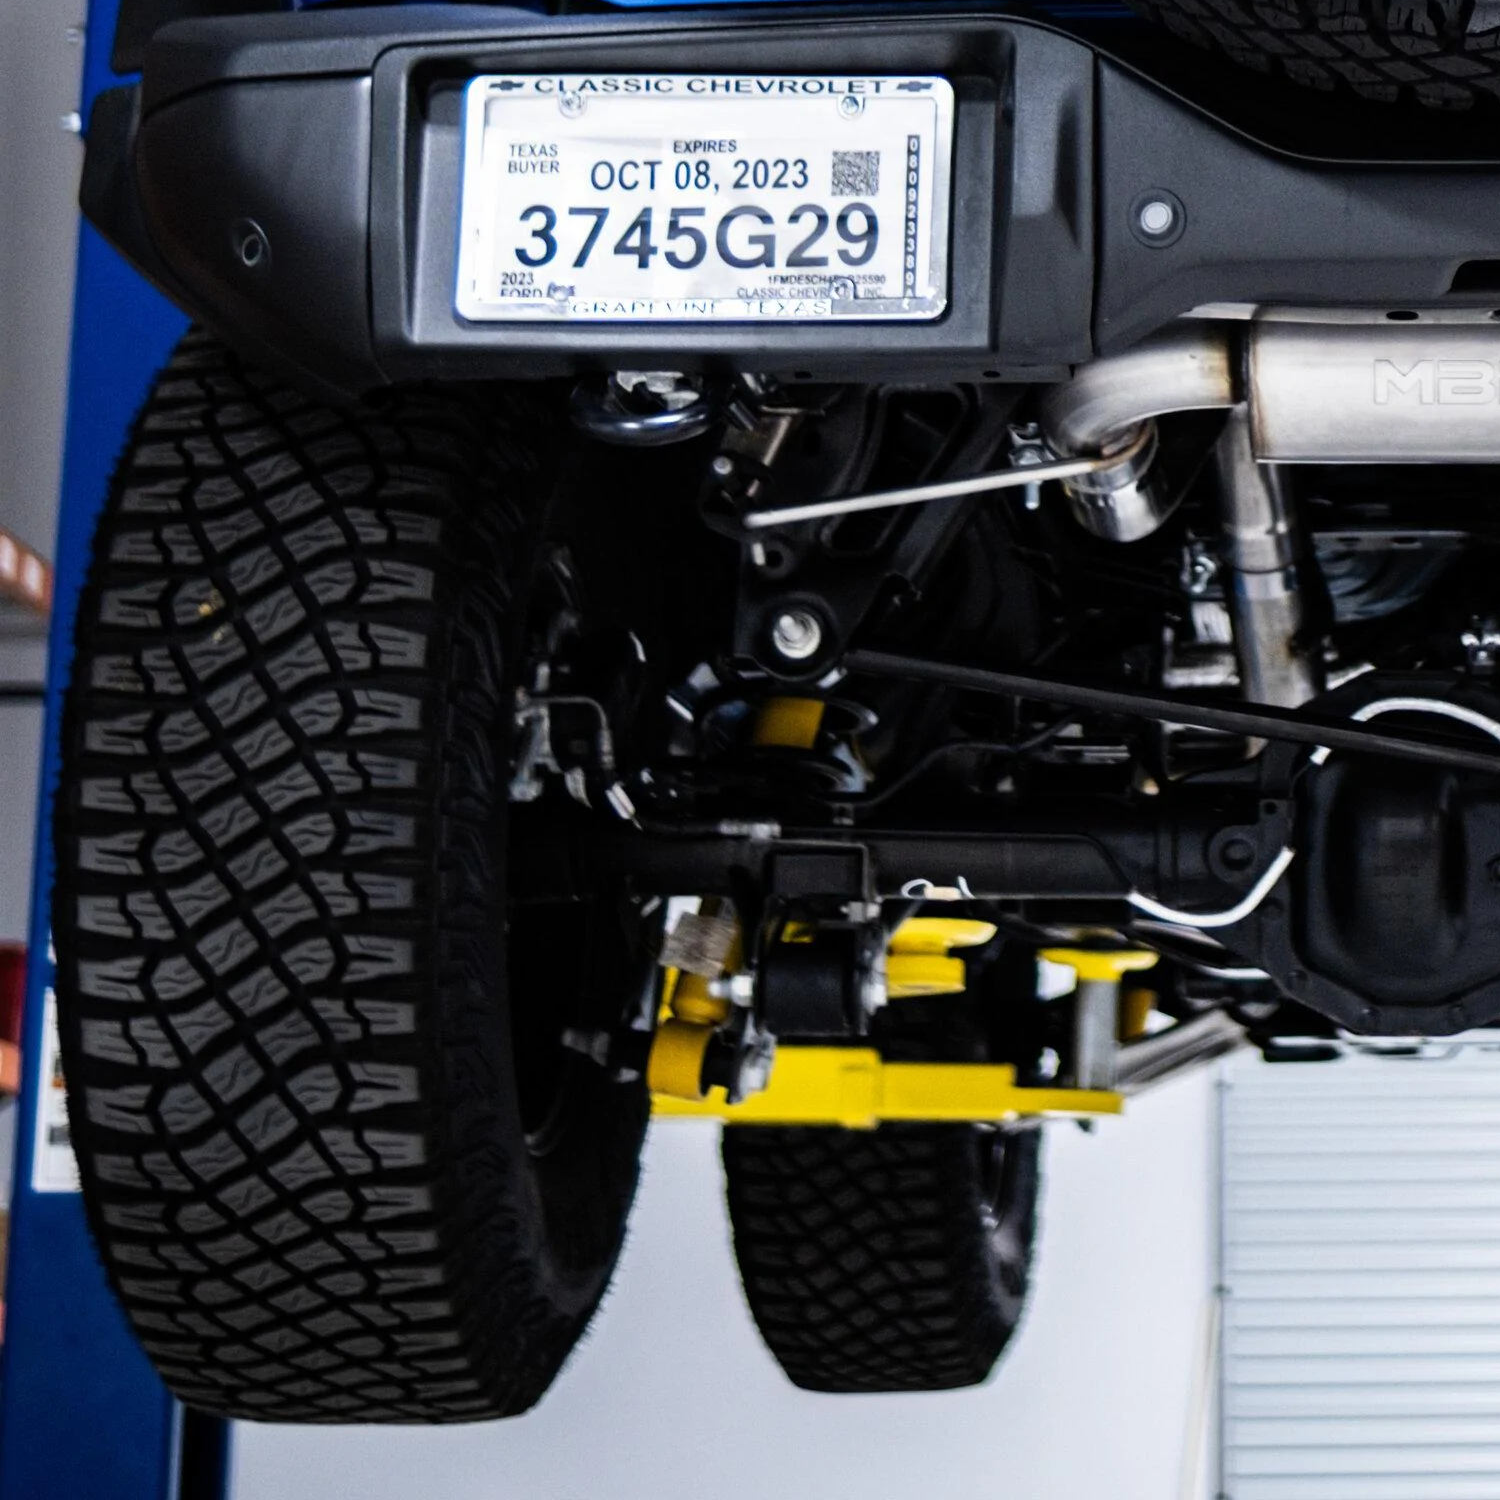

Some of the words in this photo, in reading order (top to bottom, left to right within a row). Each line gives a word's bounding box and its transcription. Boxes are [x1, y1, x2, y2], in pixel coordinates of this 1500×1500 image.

[534, 77, 675, 94] CLASSIC
[685, 76, 888, 94] CHEVROLET
[508, 143, 559, 158] TEXAS
[672, 139, 738, 155] EXPIRES
[507, 160, 561, 174] BUYER
[590, 160, 663, 191] OCT
[674, 159, 720, 195] 08,
[732, 158, 810, 190] 2023
[514, 202, 881, 269] 3745G29
[500, 272, 535, 286] 2023
[736, 286, 785, 299] CLASSIC
